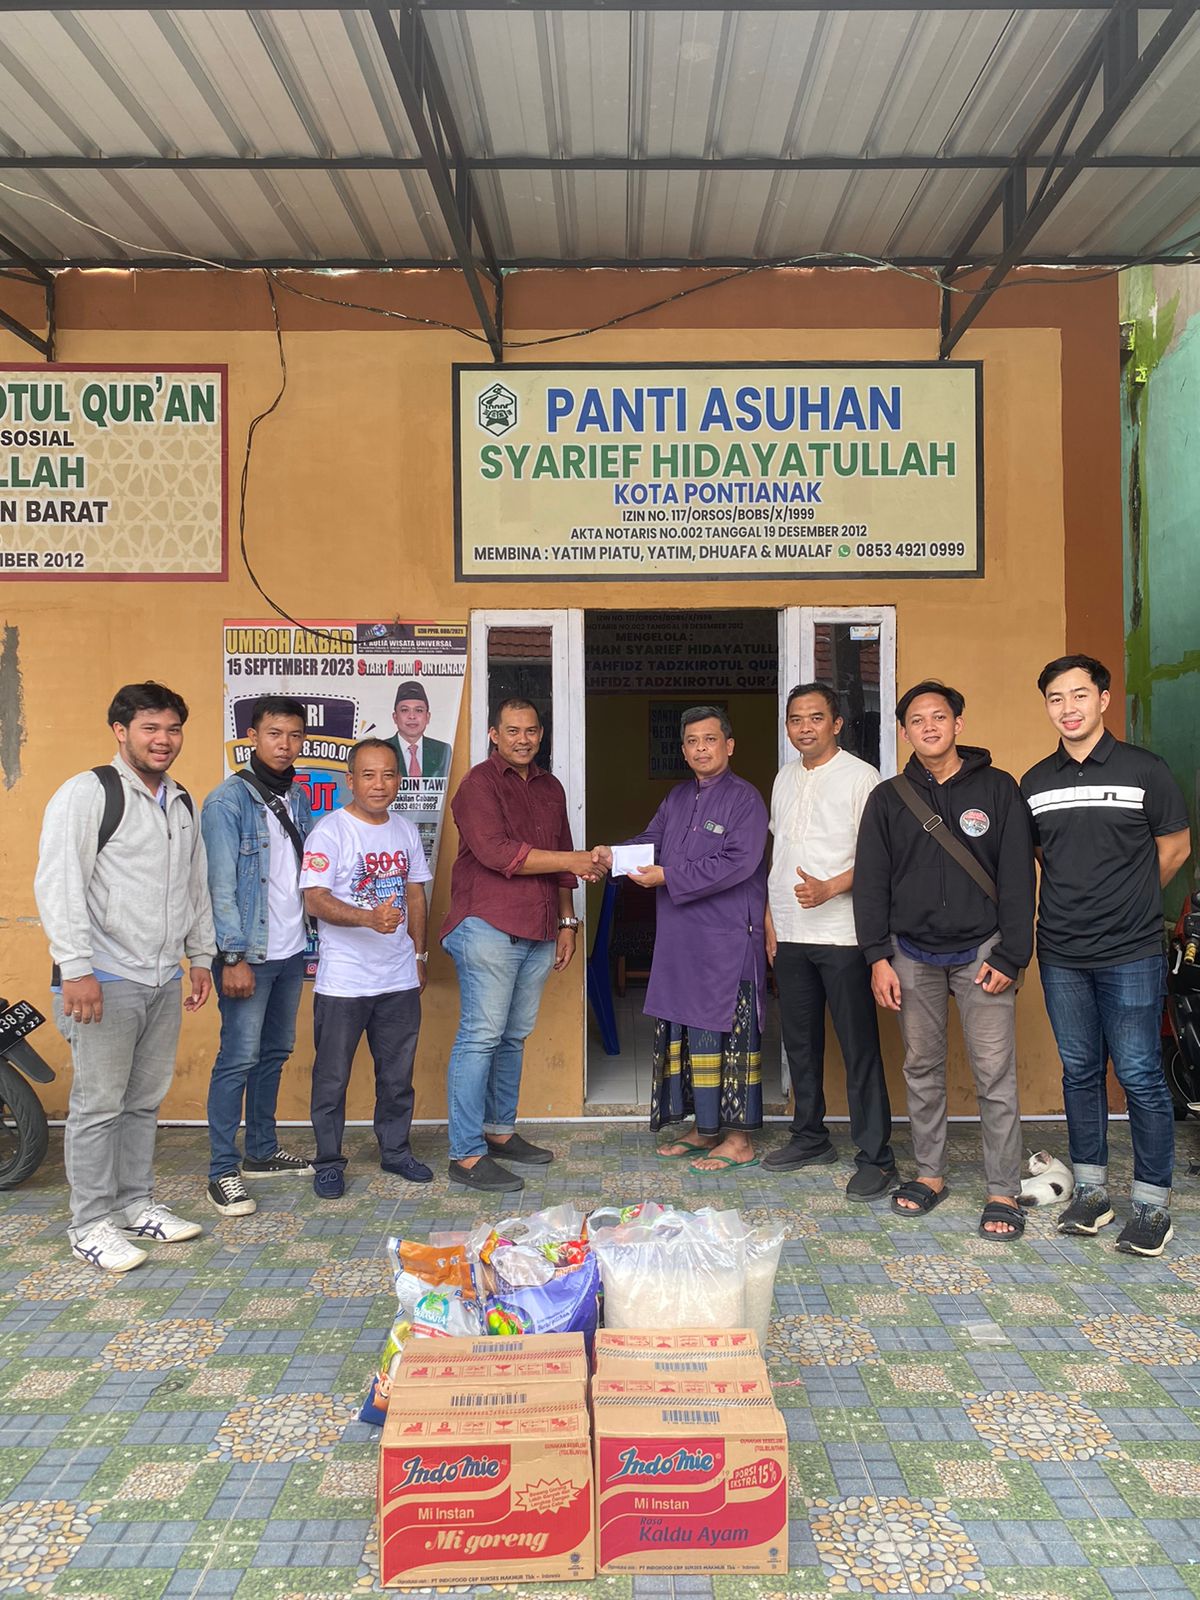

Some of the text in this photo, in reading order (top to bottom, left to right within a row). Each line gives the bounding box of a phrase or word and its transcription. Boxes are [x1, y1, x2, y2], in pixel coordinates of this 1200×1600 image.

[0, 384, 70, 421] TUL
[548, 387, 900, 432] PANTI ASUHAN
[1, 430, 74, 446] SOSIAL
[481, 442, 955, 479] SYARIEF HIDAYATULLAH
[615, 482, 822, 504] KOTA PONTIANAK
[26, 501, 108, 522] BARAT
[622, 511, 645, 522] IZIN
[571, 525, 867, 539] AKTA NOTARIS NO.002 TANGGAL 19 DESEMBER 2012
[44, 552, 84, 567] 2012
[552, 547, 596, 560] YATIM
[600, 547, 644, 561] PIATU,
[649, 546, 696, 561] YATIM,
[700, 545, 757, 558] DHUAFA
[761, 545, 772, 558] &
[775, 544, 832, 557] MUALAF
[857, 544, 892, 556] 0853
[895, 543, 926, 556] 4921
[929, 543, 965, 556] 0999
[226, 629, 353, 654] UMROH AKBAR
[626, 644, 682, 655] SYARIEF
[688, 643, 777, 655] HIDAYATULL
[227, 658, 355, 676] 15 SEPTEMBER 2023
[648, 660, 744, 671] TADZKIROTUL
[635, 676, 732, 687] TADZKIROTUL
[14, 1002, 33, 1019] SH
[735, 1465, 756, 1479] PORSI
[730, 1475, 757, 1488] EKSTRA
[634, 1497, 689, 1510] Mi Instan
[418, 1507, 474, 1520] Mi Instan
[425, 1530, 550, 1555] Mi goreng
[639, 1527, 749, 1546] Kaldu Ayam
